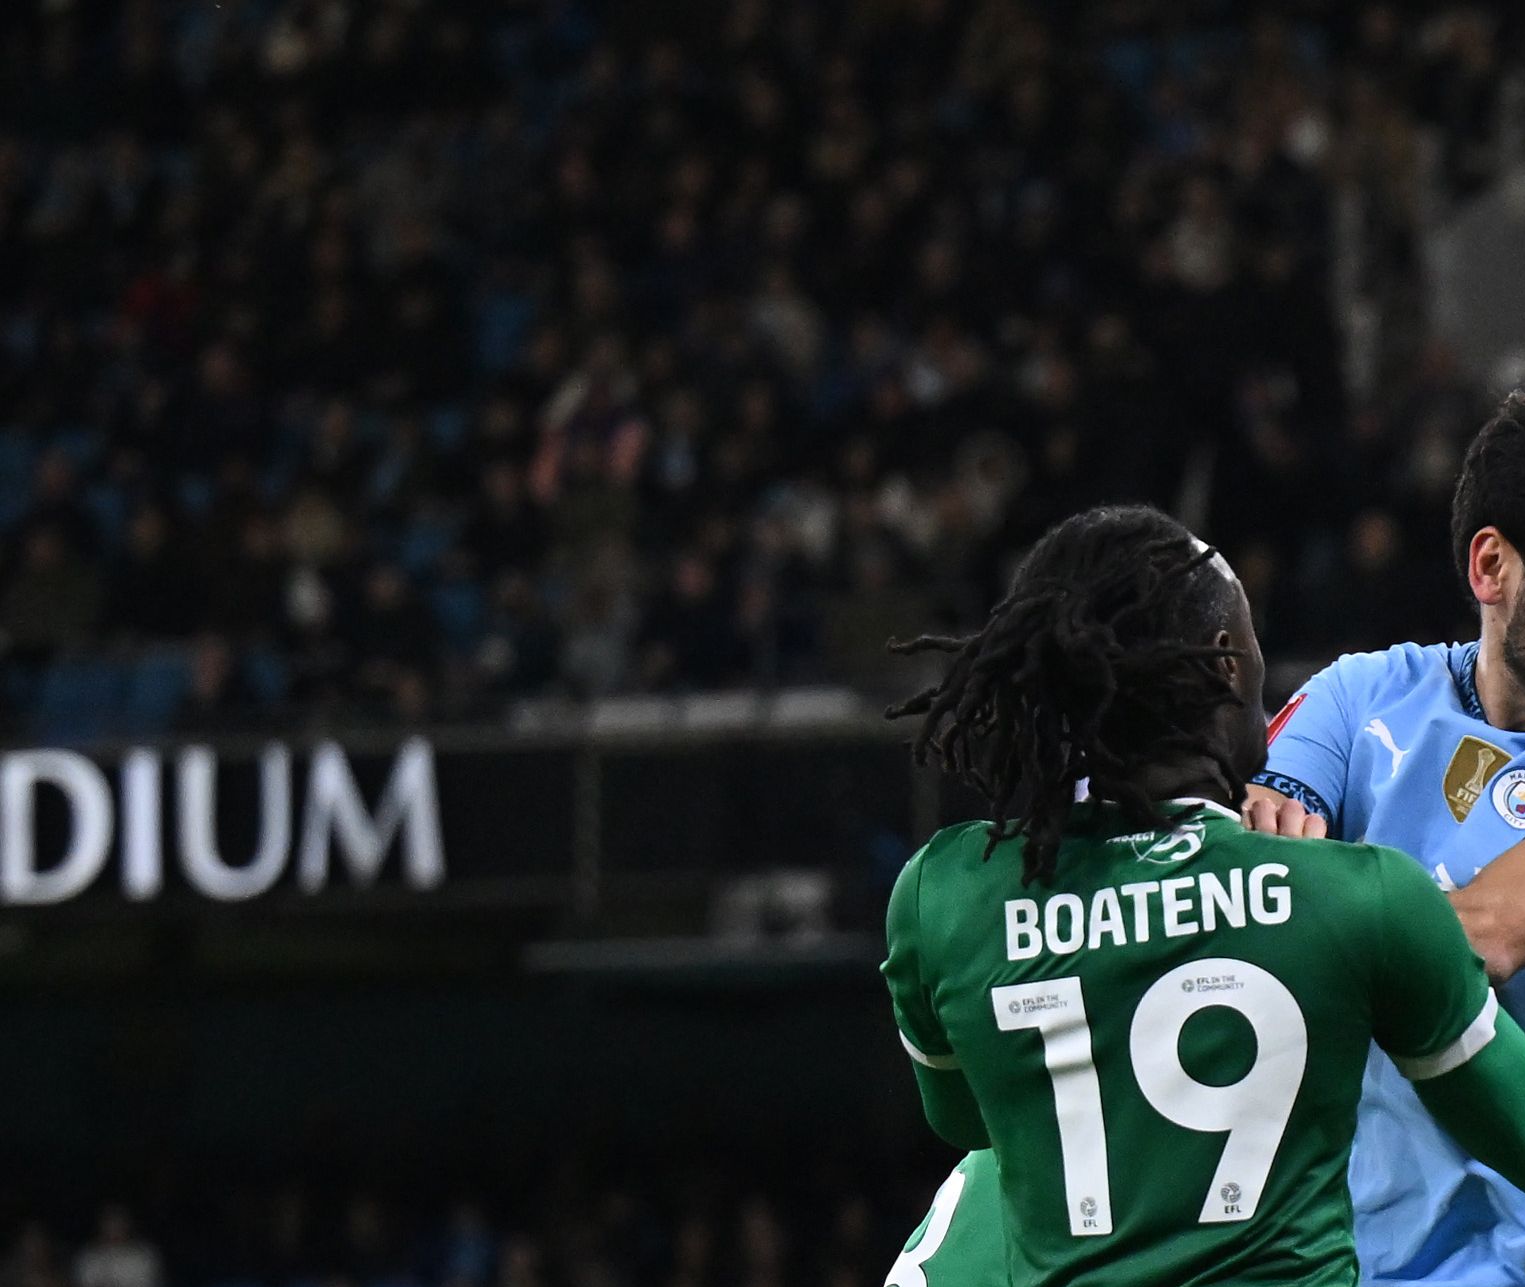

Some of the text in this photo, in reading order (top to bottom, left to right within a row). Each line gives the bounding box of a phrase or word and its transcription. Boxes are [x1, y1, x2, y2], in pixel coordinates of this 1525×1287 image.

[0, 735, 448, 905] DIUM
[1004, 863, 1292, 961] BOATENG
[990, 957, 1308, 1236] 19
[1083, 1219, 1098, 1228] EFL
[1225, 1204, 1242, 1214] EFL
